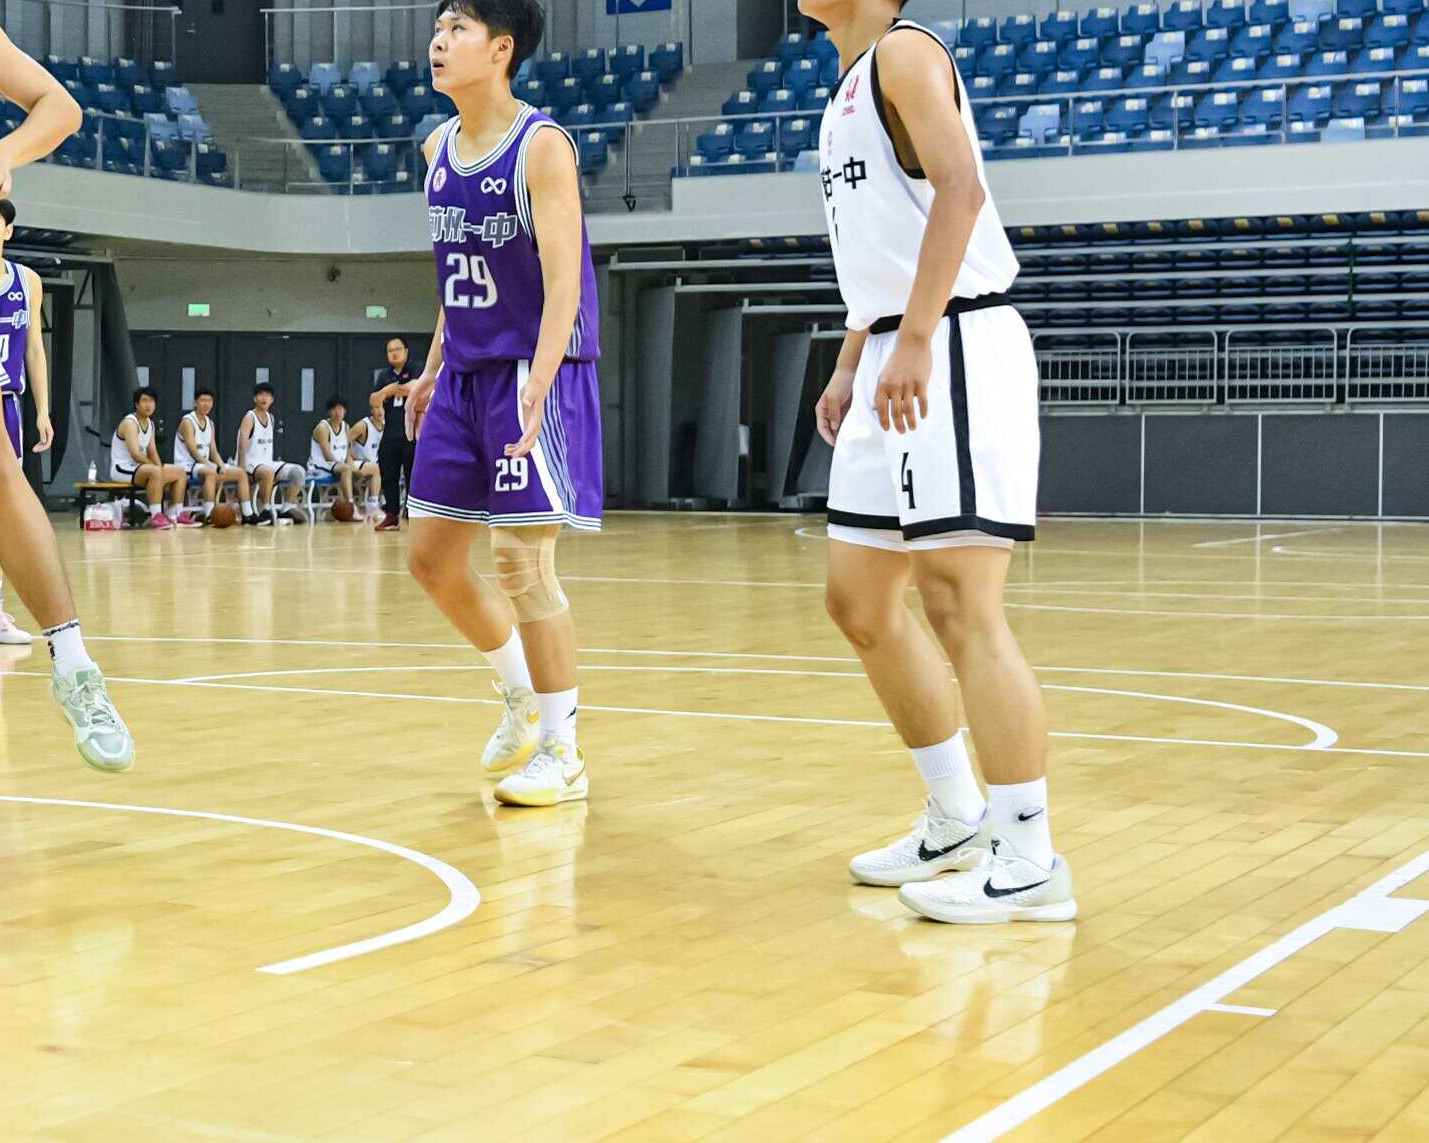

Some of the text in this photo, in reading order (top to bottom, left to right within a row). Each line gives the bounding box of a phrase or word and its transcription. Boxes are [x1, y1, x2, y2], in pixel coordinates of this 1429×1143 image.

[444, 252, 498, 309] 29
[495, 456, 529, 492] 29
[901, 451, 917, 509] 4
